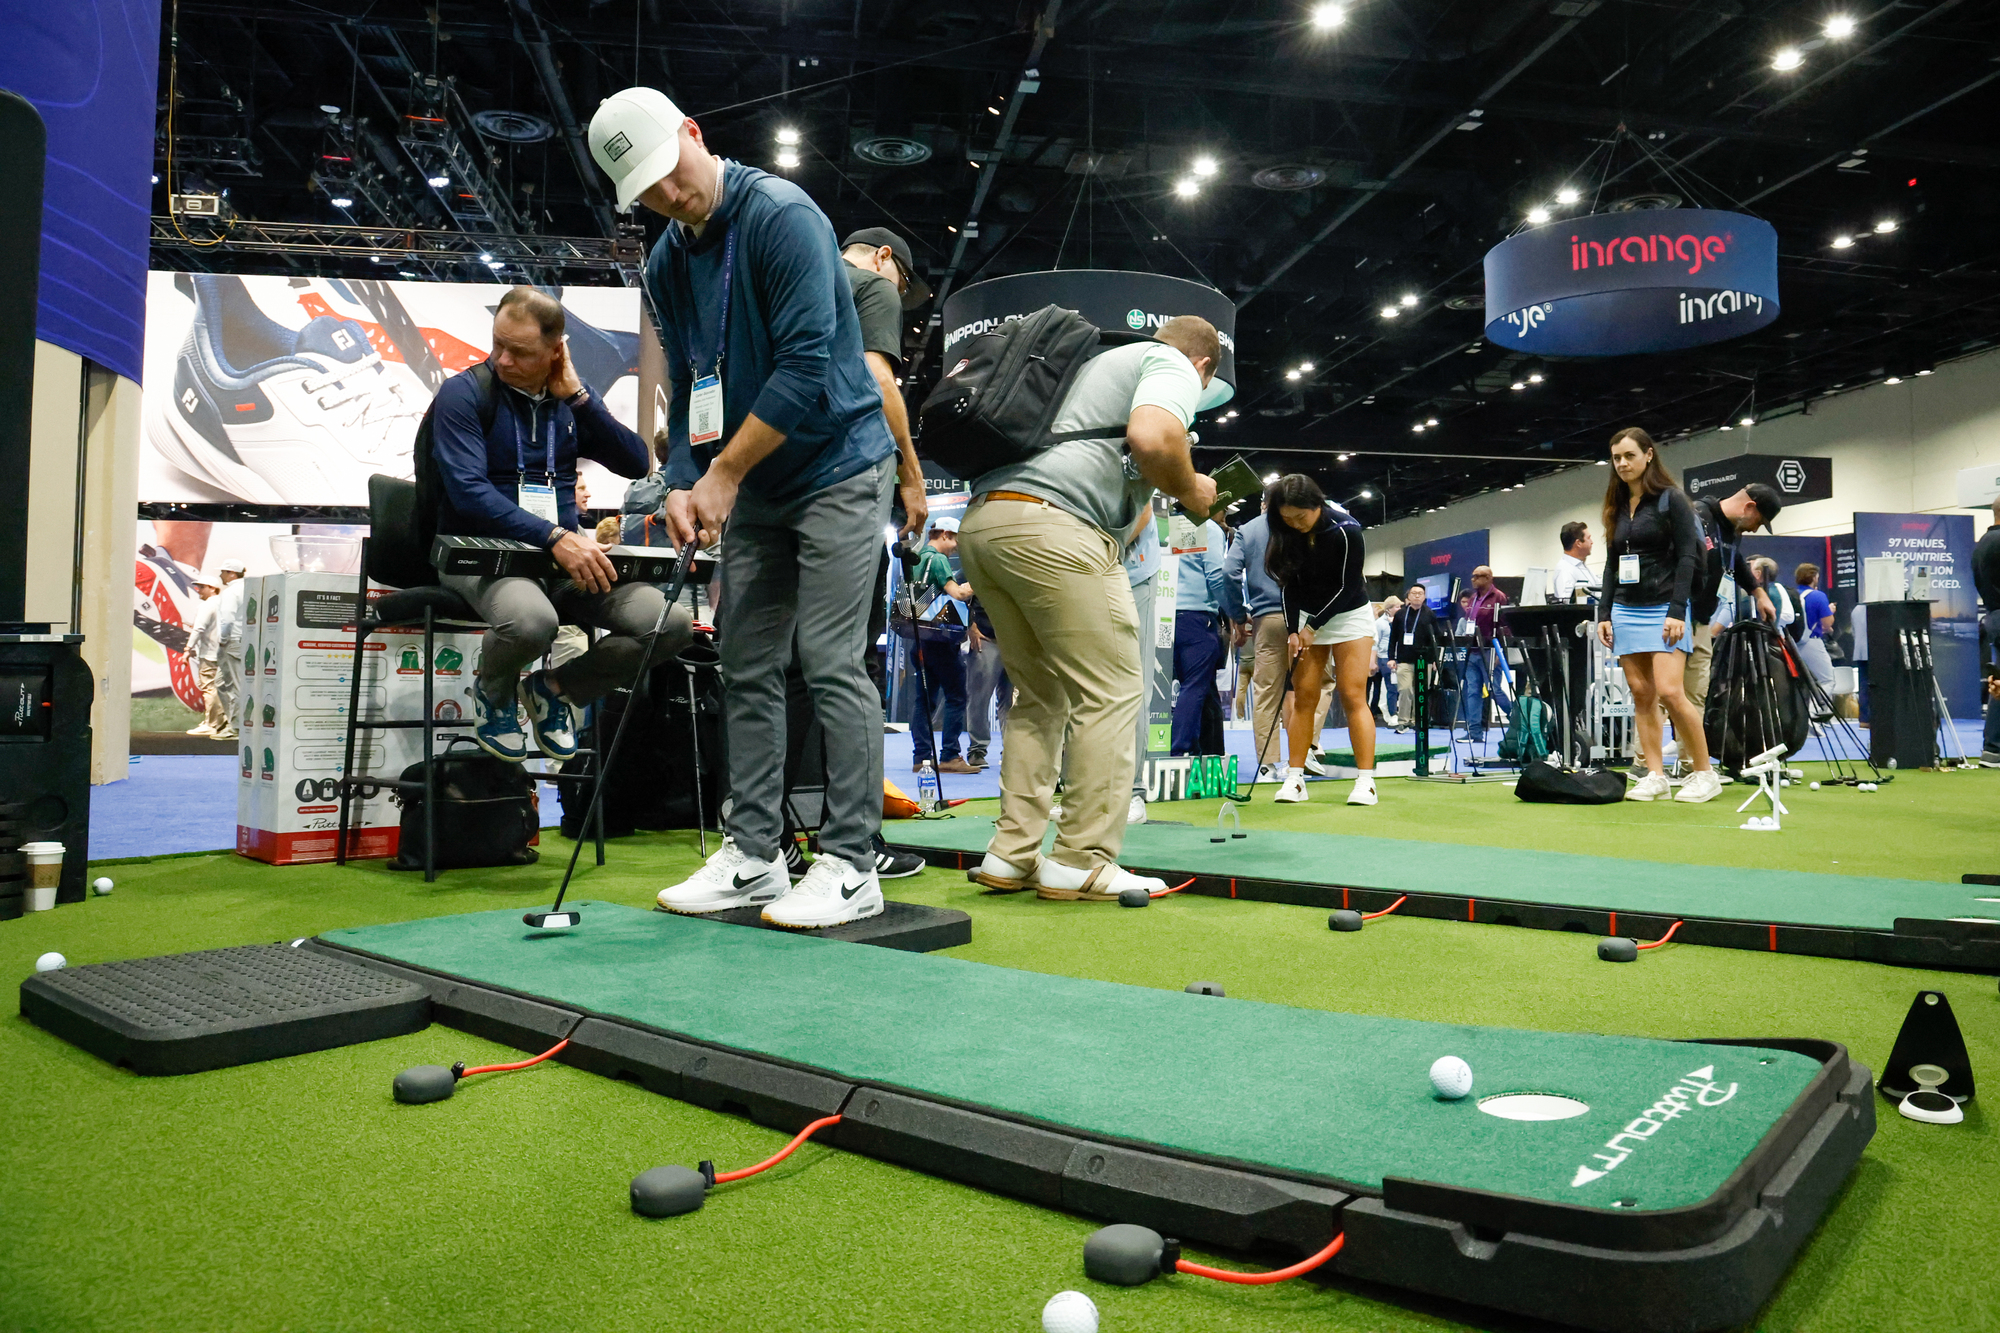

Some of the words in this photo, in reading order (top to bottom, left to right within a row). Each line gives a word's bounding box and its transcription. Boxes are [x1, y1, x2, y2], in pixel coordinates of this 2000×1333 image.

[1700, 474, 1737, 488] BETTINARDI
[1888, 538, 1901, 547] 97
[1903, 538, 1947, 549] VENUES,
[1894, 551, 1955, 563] COUNTRIES,
[1417, 659, 1425, 765] Makefield
[1142, 754, 1239, 802] UTTAIM
